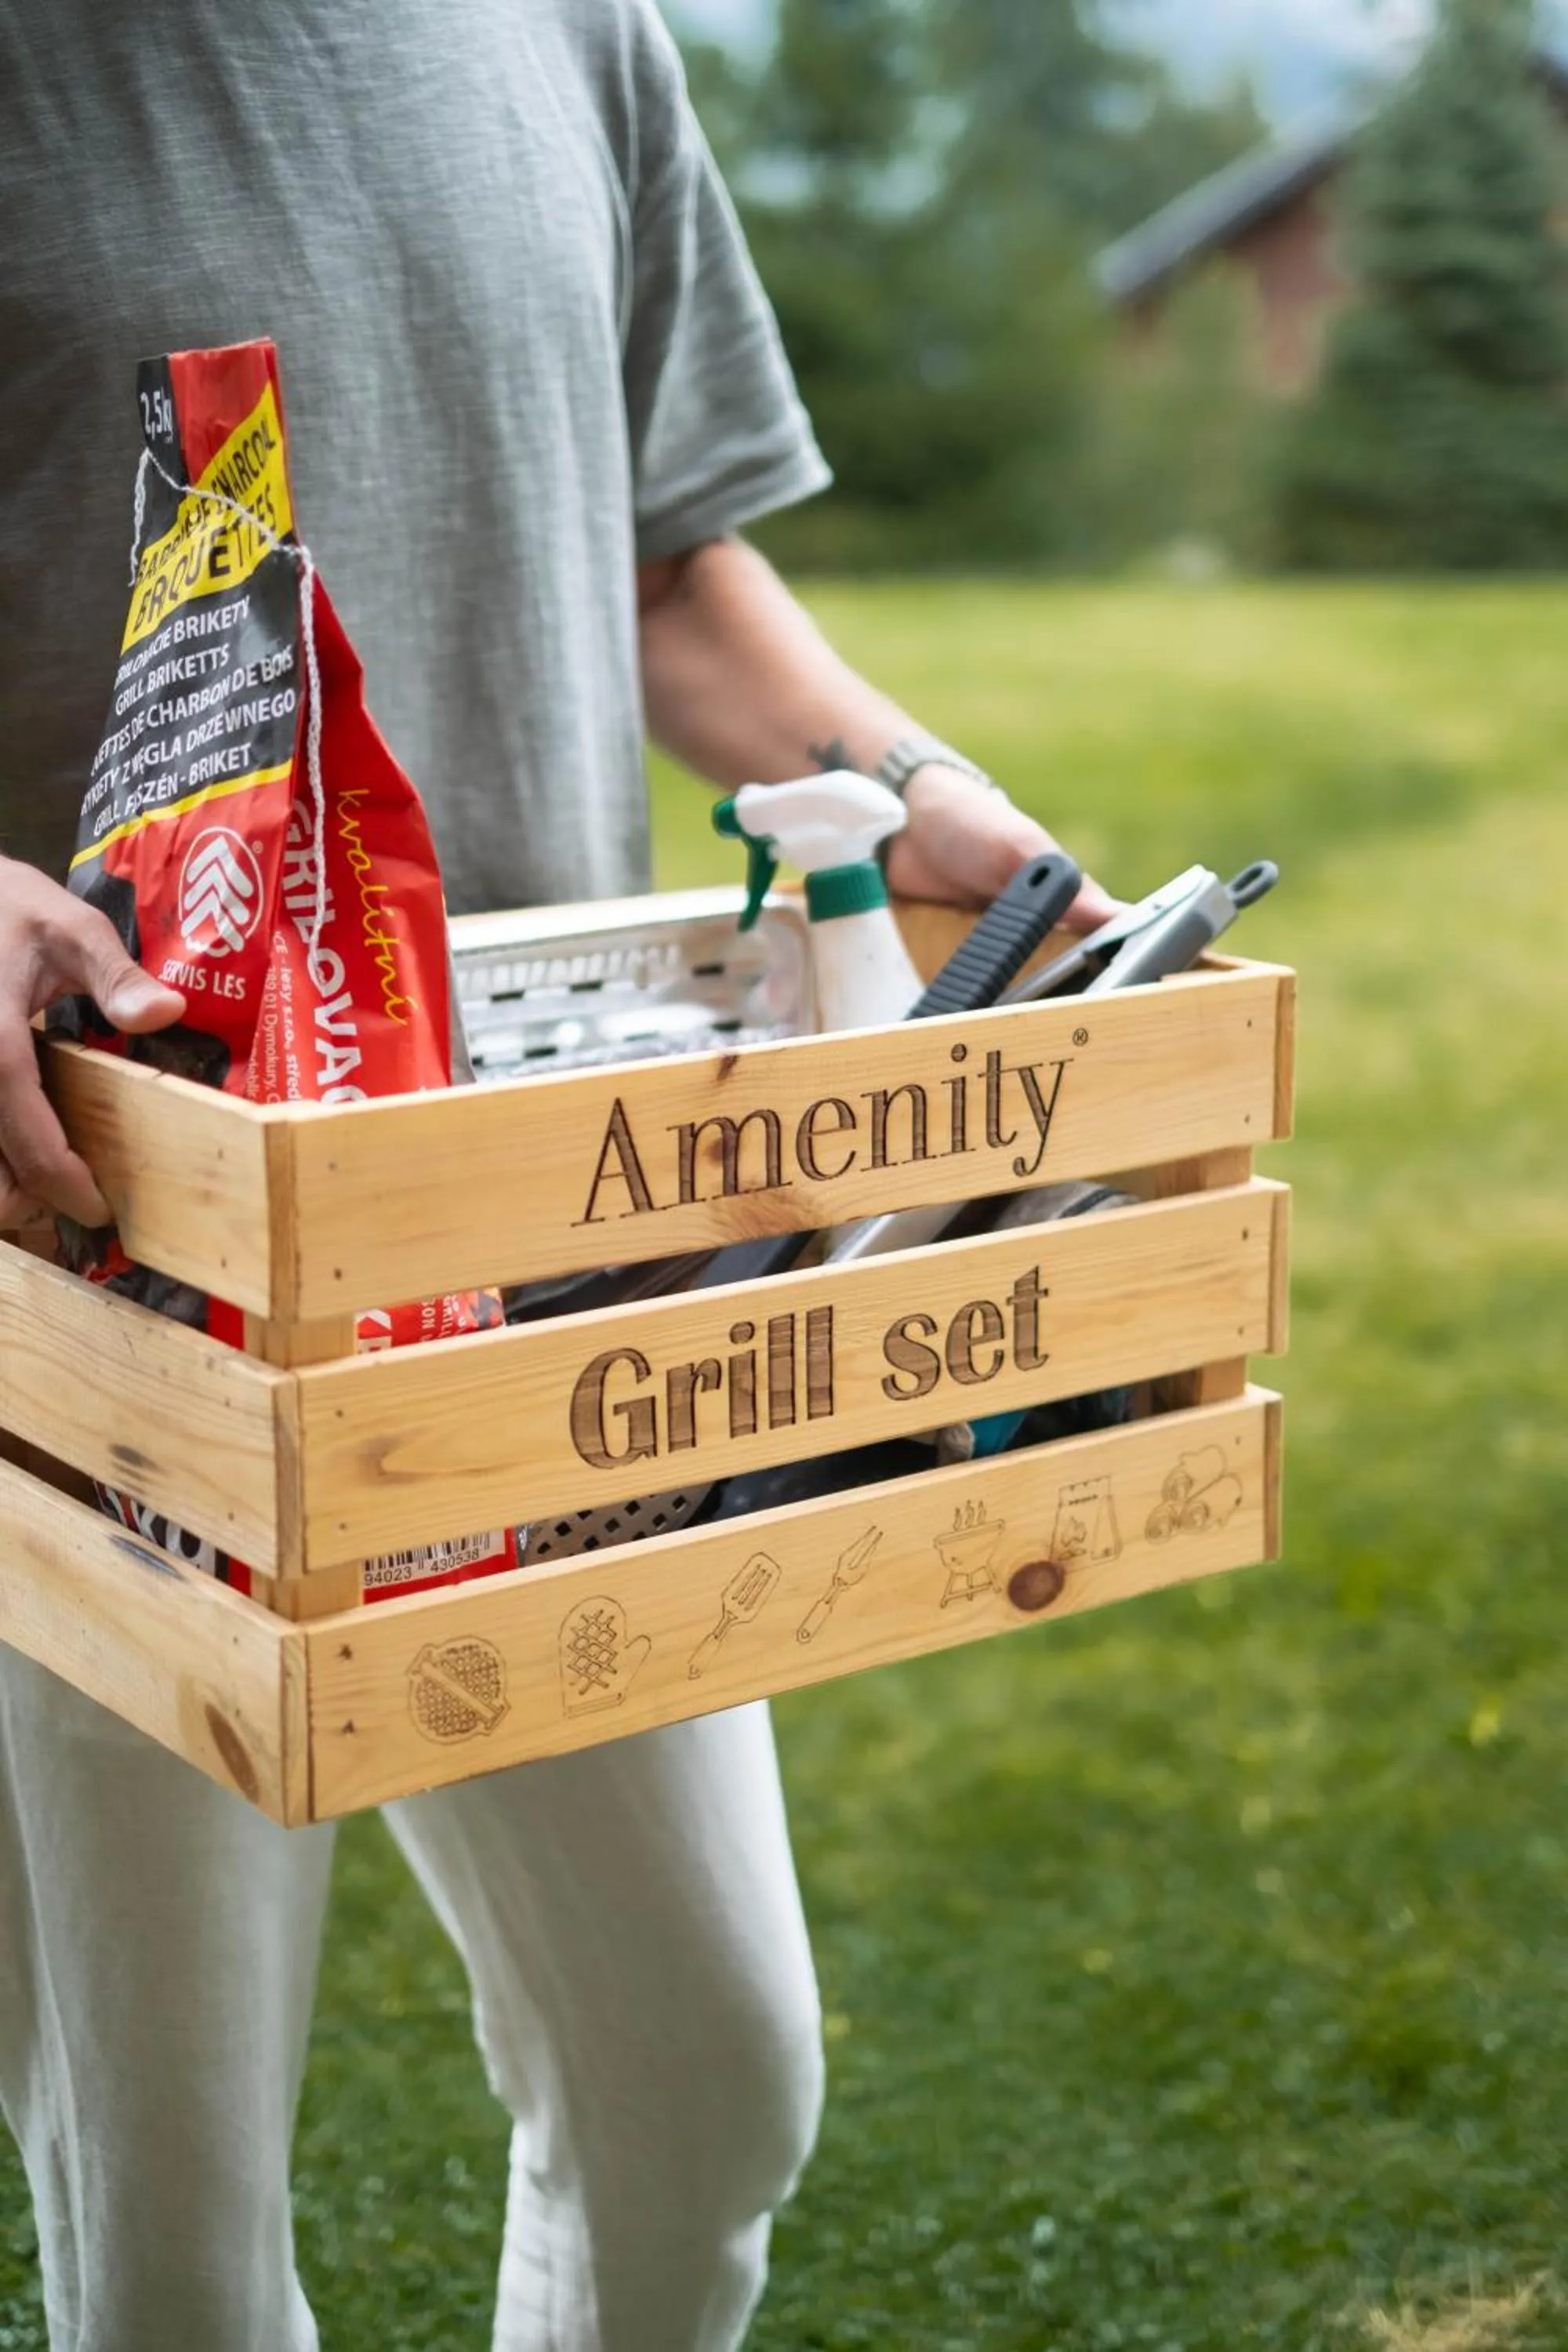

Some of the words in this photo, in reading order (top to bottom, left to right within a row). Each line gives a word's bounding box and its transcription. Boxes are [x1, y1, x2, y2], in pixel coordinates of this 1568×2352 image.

[210, 419, 276, 514] CHARCOL
[172, 595, 250, 644] BRIKETY
[115, 679, 144, 716] GRILL
[147, 642, 230, 694] BRIKETTS
[131, 710, 145, 741] DE
[146, 674, 231, 728] CHARBON
[231, 664, 259, 693] DE
[122, 760, 132, 785] Z
[186, 688, 296, 753] DRZEWNEGO
[93, 800, 121, 837] GRILL
[187, 742, 252, 786] BRIKET
[213, 971, 246, 1000] LES
[571, 1044, 1076, 1228] Amenity
[569, 1305, 835, 1472] Grill
[880, 1264, 1051, 1402] set
